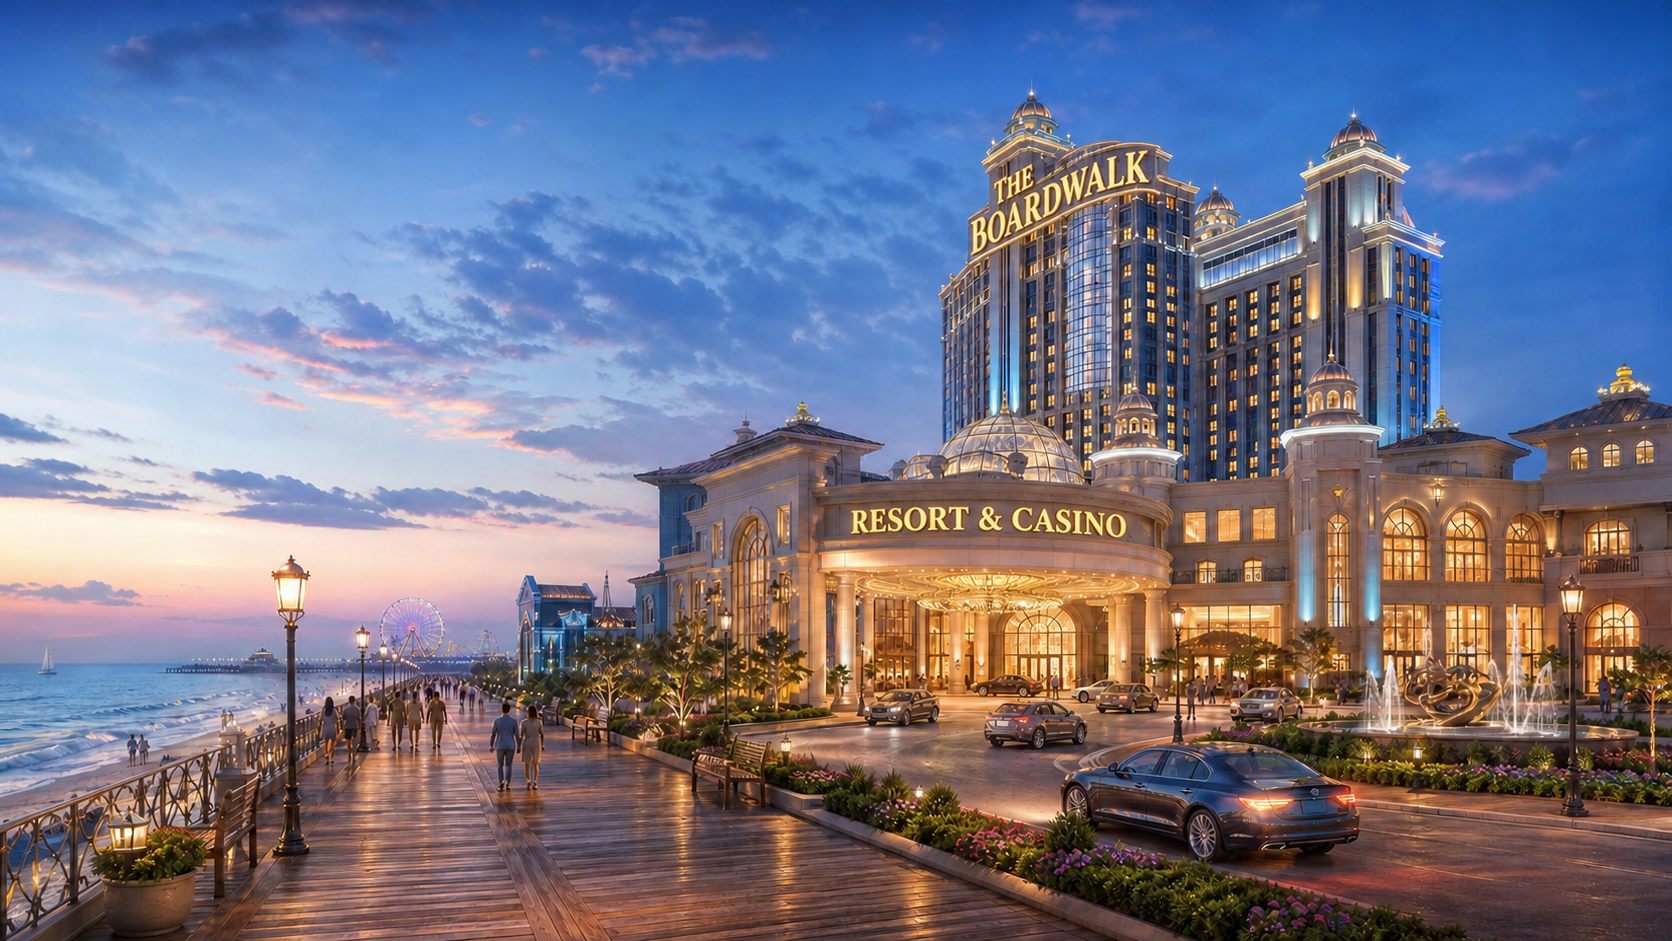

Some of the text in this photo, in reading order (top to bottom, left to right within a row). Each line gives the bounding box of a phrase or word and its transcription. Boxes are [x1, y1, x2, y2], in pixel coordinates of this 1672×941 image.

[970, 150, 1149, 256] BOARDWALK
[994, 164, 1034, 205] THE
[850, 506, 1127, 538] RESORT & CASINO
